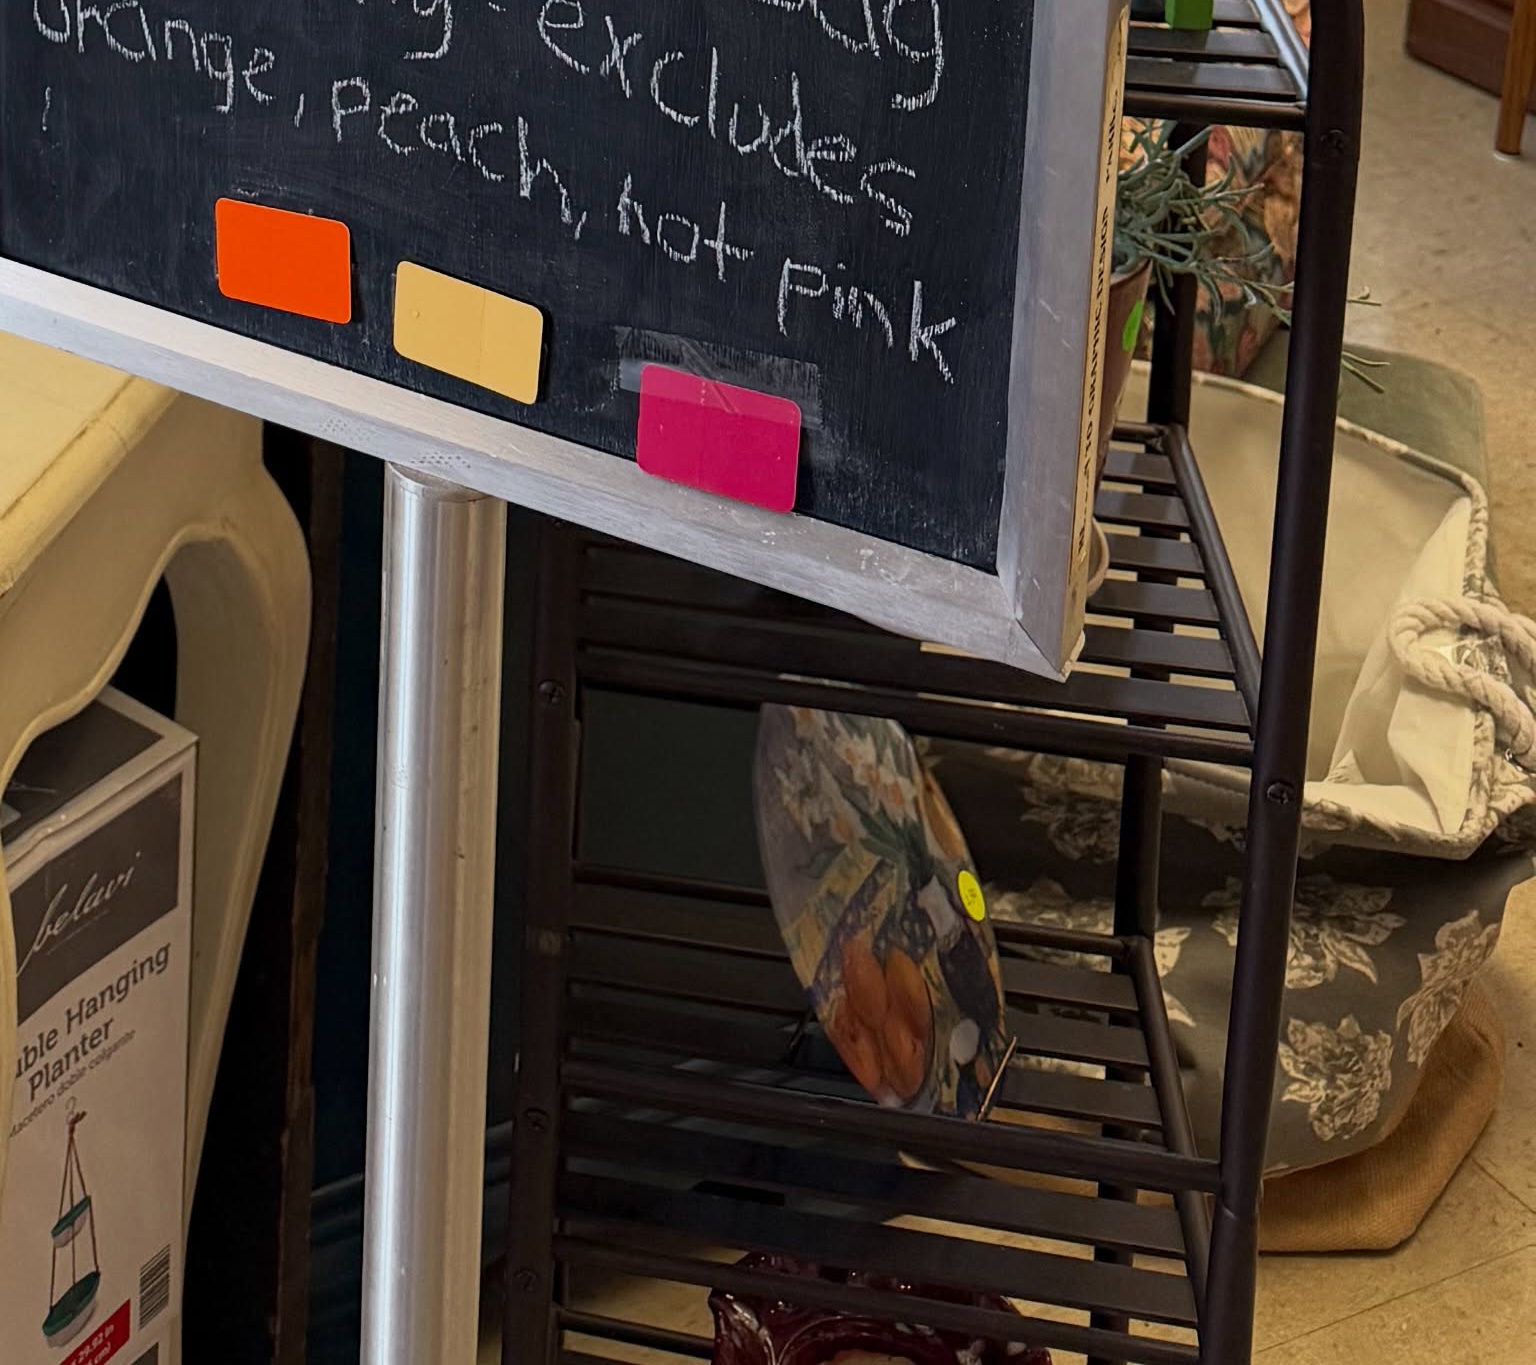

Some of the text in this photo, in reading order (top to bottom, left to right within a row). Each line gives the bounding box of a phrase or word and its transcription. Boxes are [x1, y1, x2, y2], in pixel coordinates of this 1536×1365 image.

[617, 171, 756, 283] hot
[1087, 300, 1103, 417] GRAPHIC
[1096, 205, 1109, 299] DESIGN
[15, 942, 172, 1079] uble Hanging
[28, 1016, 115, 1103] Planter
